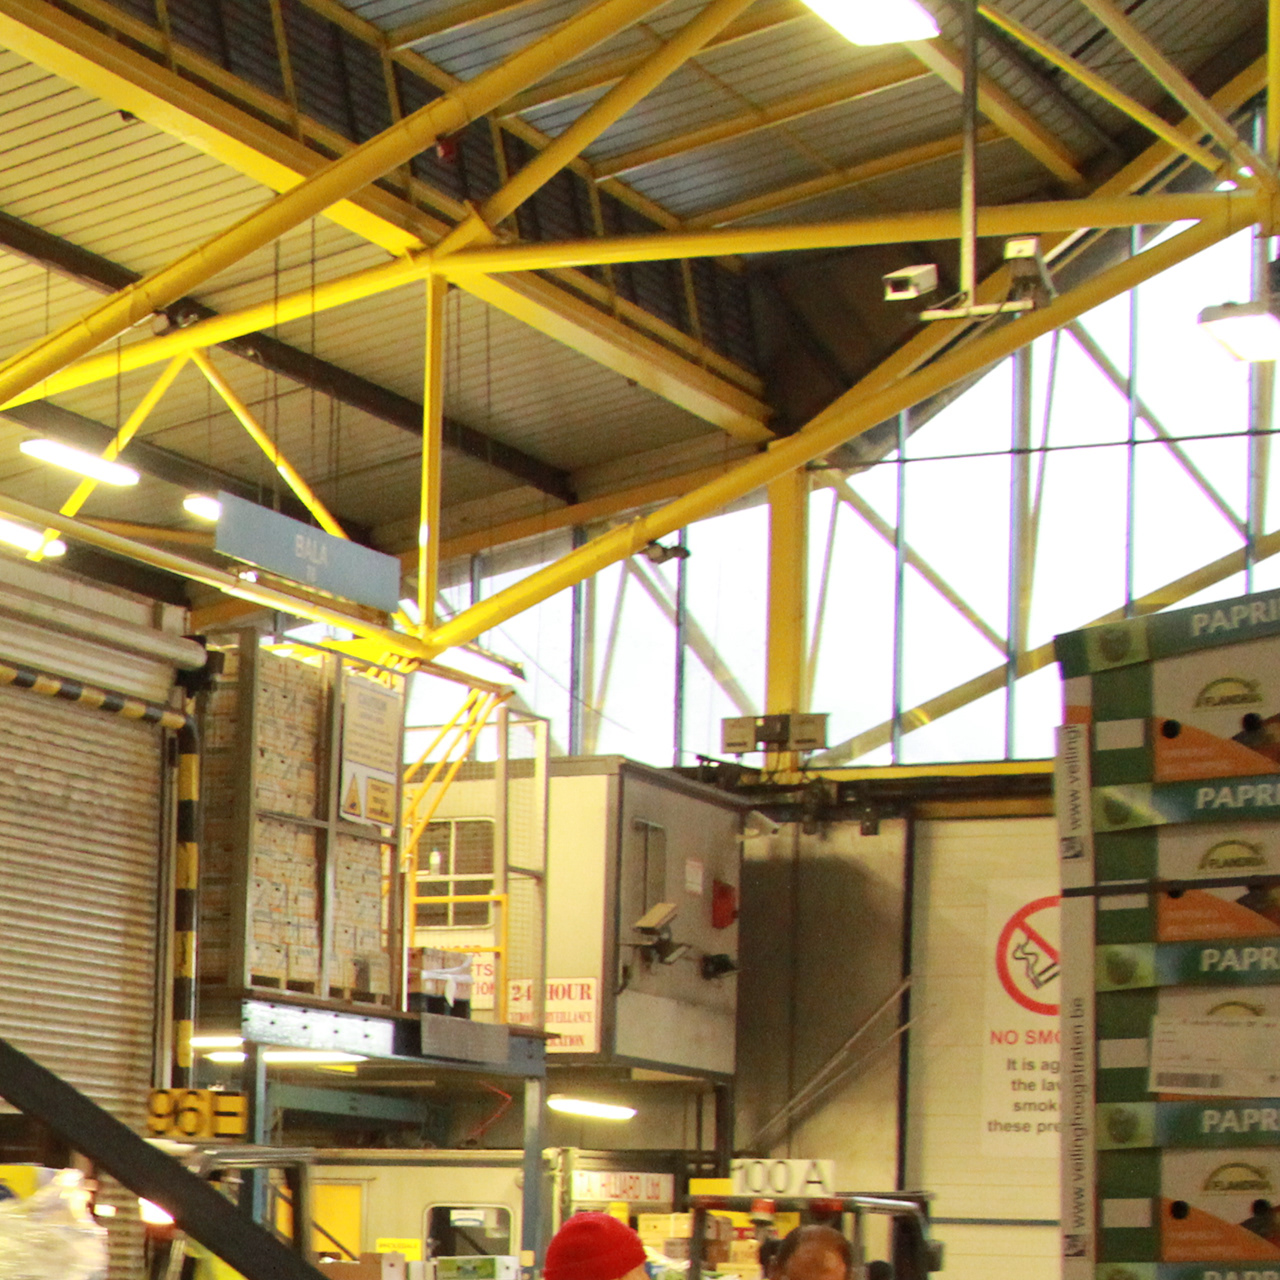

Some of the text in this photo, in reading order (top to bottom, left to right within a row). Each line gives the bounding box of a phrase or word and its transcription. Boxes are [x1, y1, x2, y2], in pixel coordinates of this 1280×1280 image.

[1191, 600, 1280, 637] PAPRI
[1196, 783, 1280, 812] PAPR
[1201, 946, 1280, 973] PAPR
[990, 1029, 1019, 1045] NO
[1006, 1058, 1060, 1074] It is ag
[1011, 1079, 1037, 1091] the
[1013, 1098, 1057, 1112] smok
[987, 1119, 1061, 1135] these pre
[1202, 1108, 1280, 1133] PAPR
